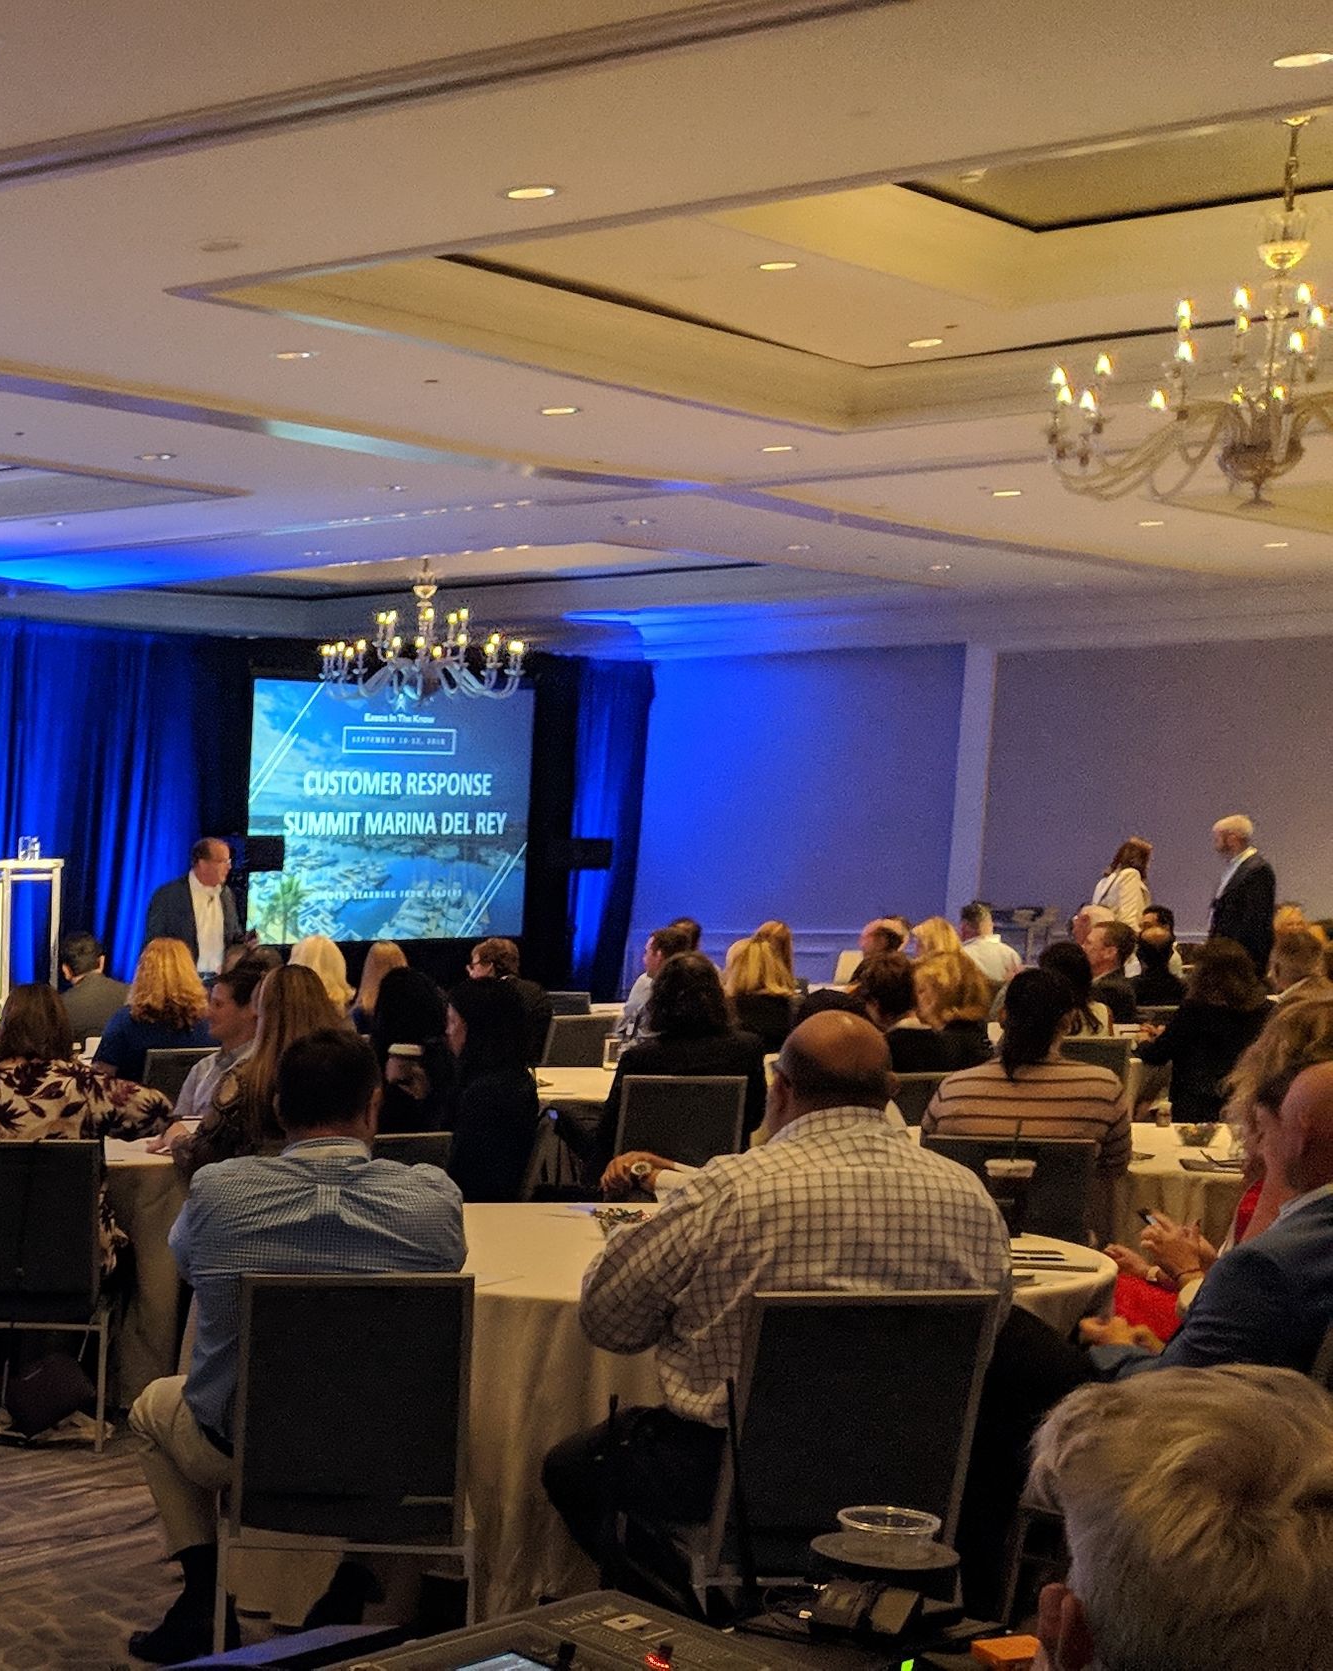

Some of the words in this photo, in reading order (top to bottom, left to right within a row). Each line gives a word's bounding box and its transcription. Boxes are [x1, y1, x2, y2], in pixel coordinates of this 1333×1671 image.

[303, 769, 403, 797] CUSTOMER
[406, 771, 493, 797] RESPONSE
[283, 811, 362, 837] SUMMIT
[364, 811, 437, 836] MARINA
[441, 812, 472, 836] DEL
[475, 812, 508, 836] REY
